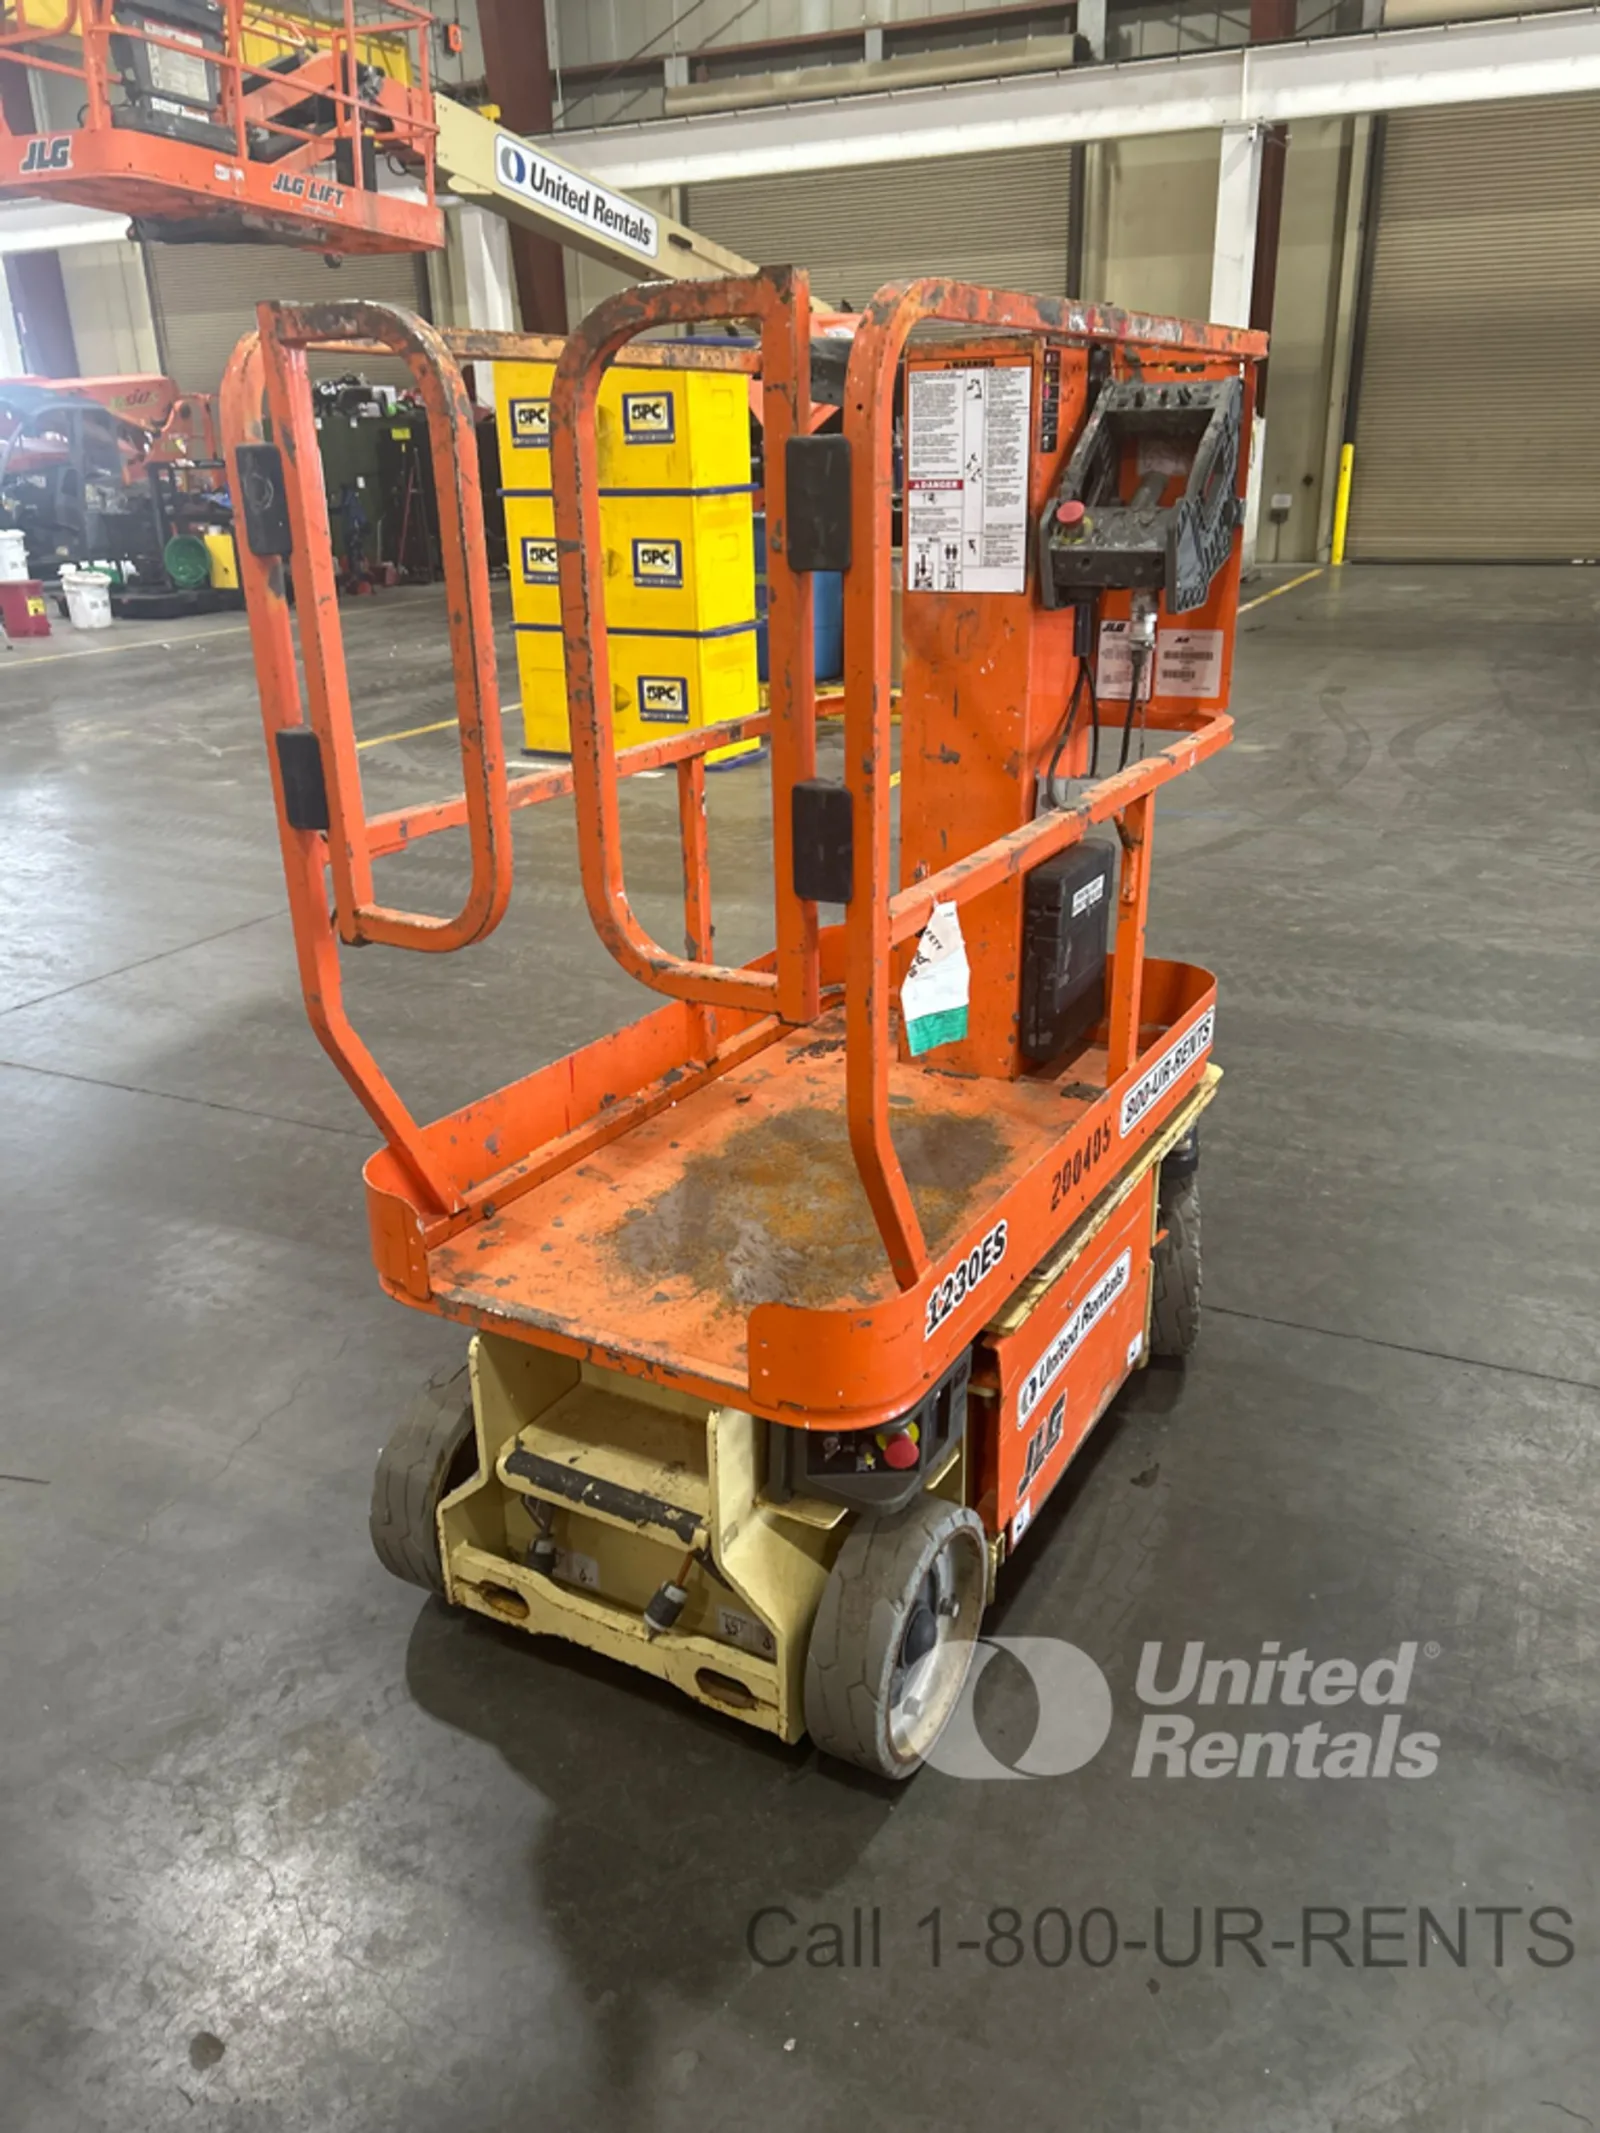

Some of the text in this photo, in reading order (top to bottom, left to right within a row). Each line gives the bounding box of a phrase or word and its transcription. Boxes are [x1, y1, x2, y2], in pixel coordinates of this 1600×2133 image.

[21, 137, 71, 172] JLG
[272, 172, 304, 197] JLG
[308, 181, 345, 208] LIFT
[530, 161, 651, 246] United Rentals
[921, 479, 959, 489] DANGER
[1102, 623, 1126, 633] JLG
[1124, 1016, 1213, 1125] 800-UR-RENTS
[926, 1222, 1006, 1336] 1230ES
[1036, 1265, 1126, 1390] United Rentals
[1016, 1391, 1066, 1501] JLG
